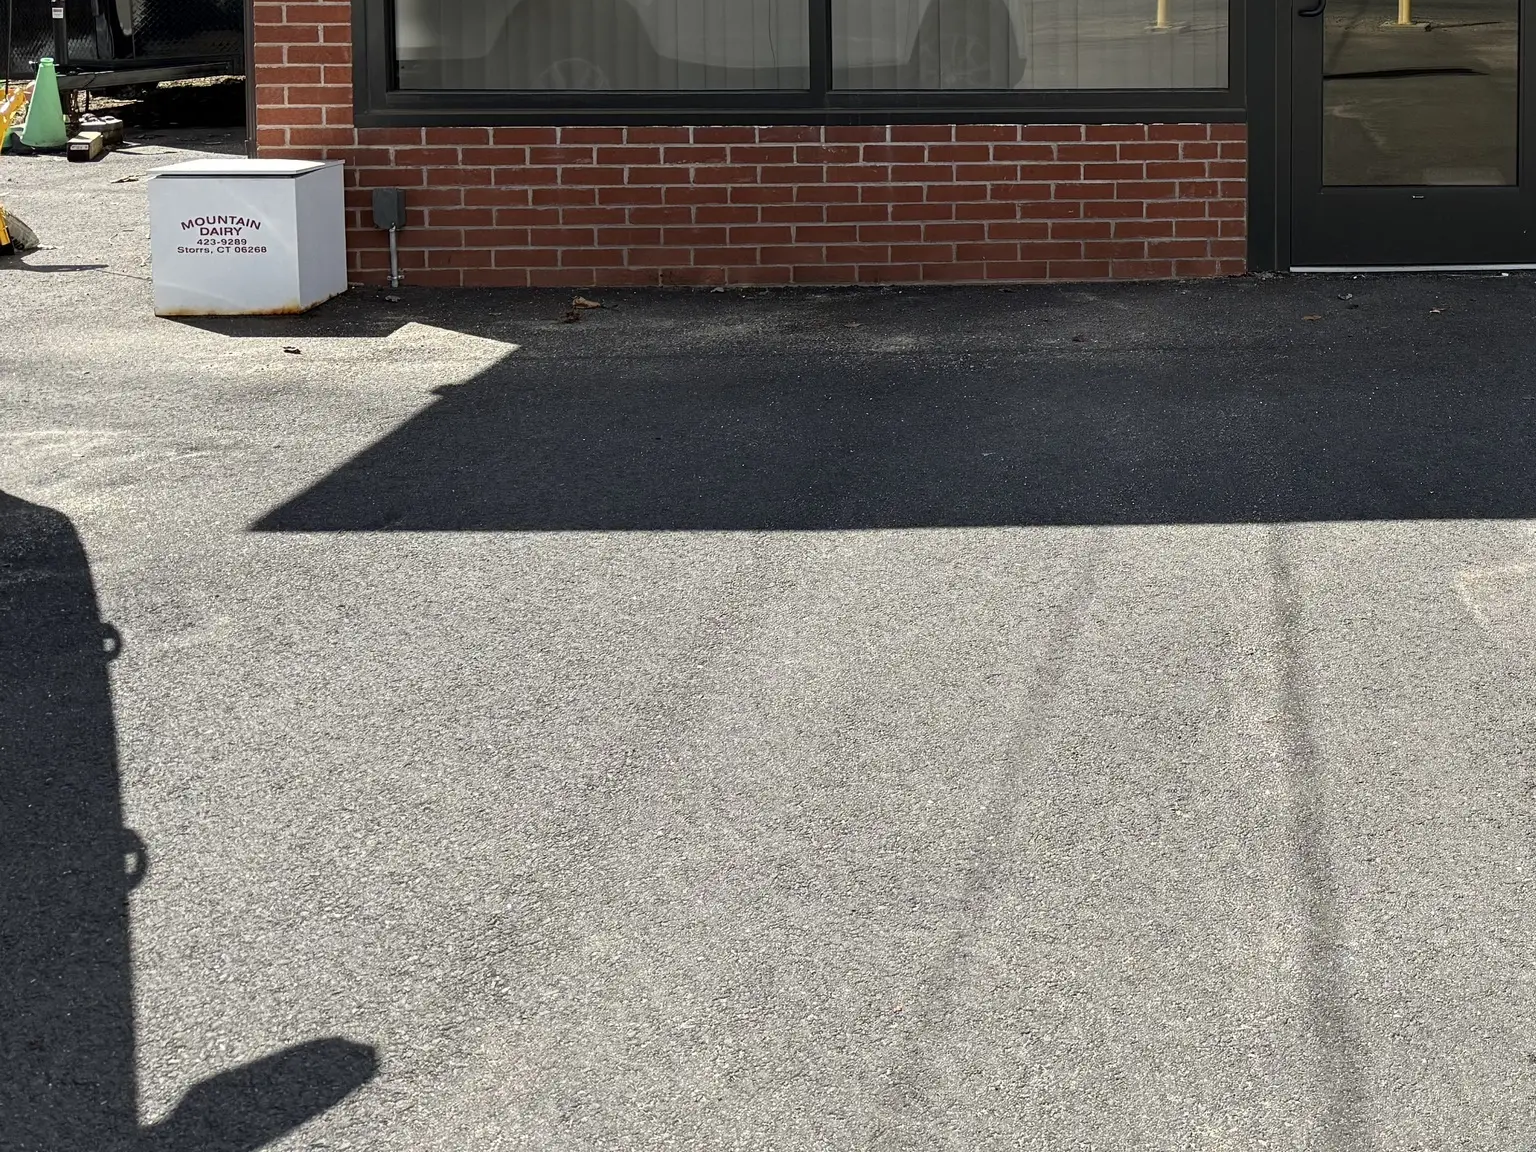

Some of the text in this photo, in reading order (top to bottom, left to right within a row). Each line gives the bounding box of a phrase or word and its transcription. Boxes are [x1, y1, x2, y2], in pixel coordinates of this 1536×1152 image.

[180, 215, 262, 230] MOUNTAIN
[199, 227, 243, 236] DAIRY
[196, 238, 247, 246] 423-9289
[177, 246, 213, 254] Storrs,
